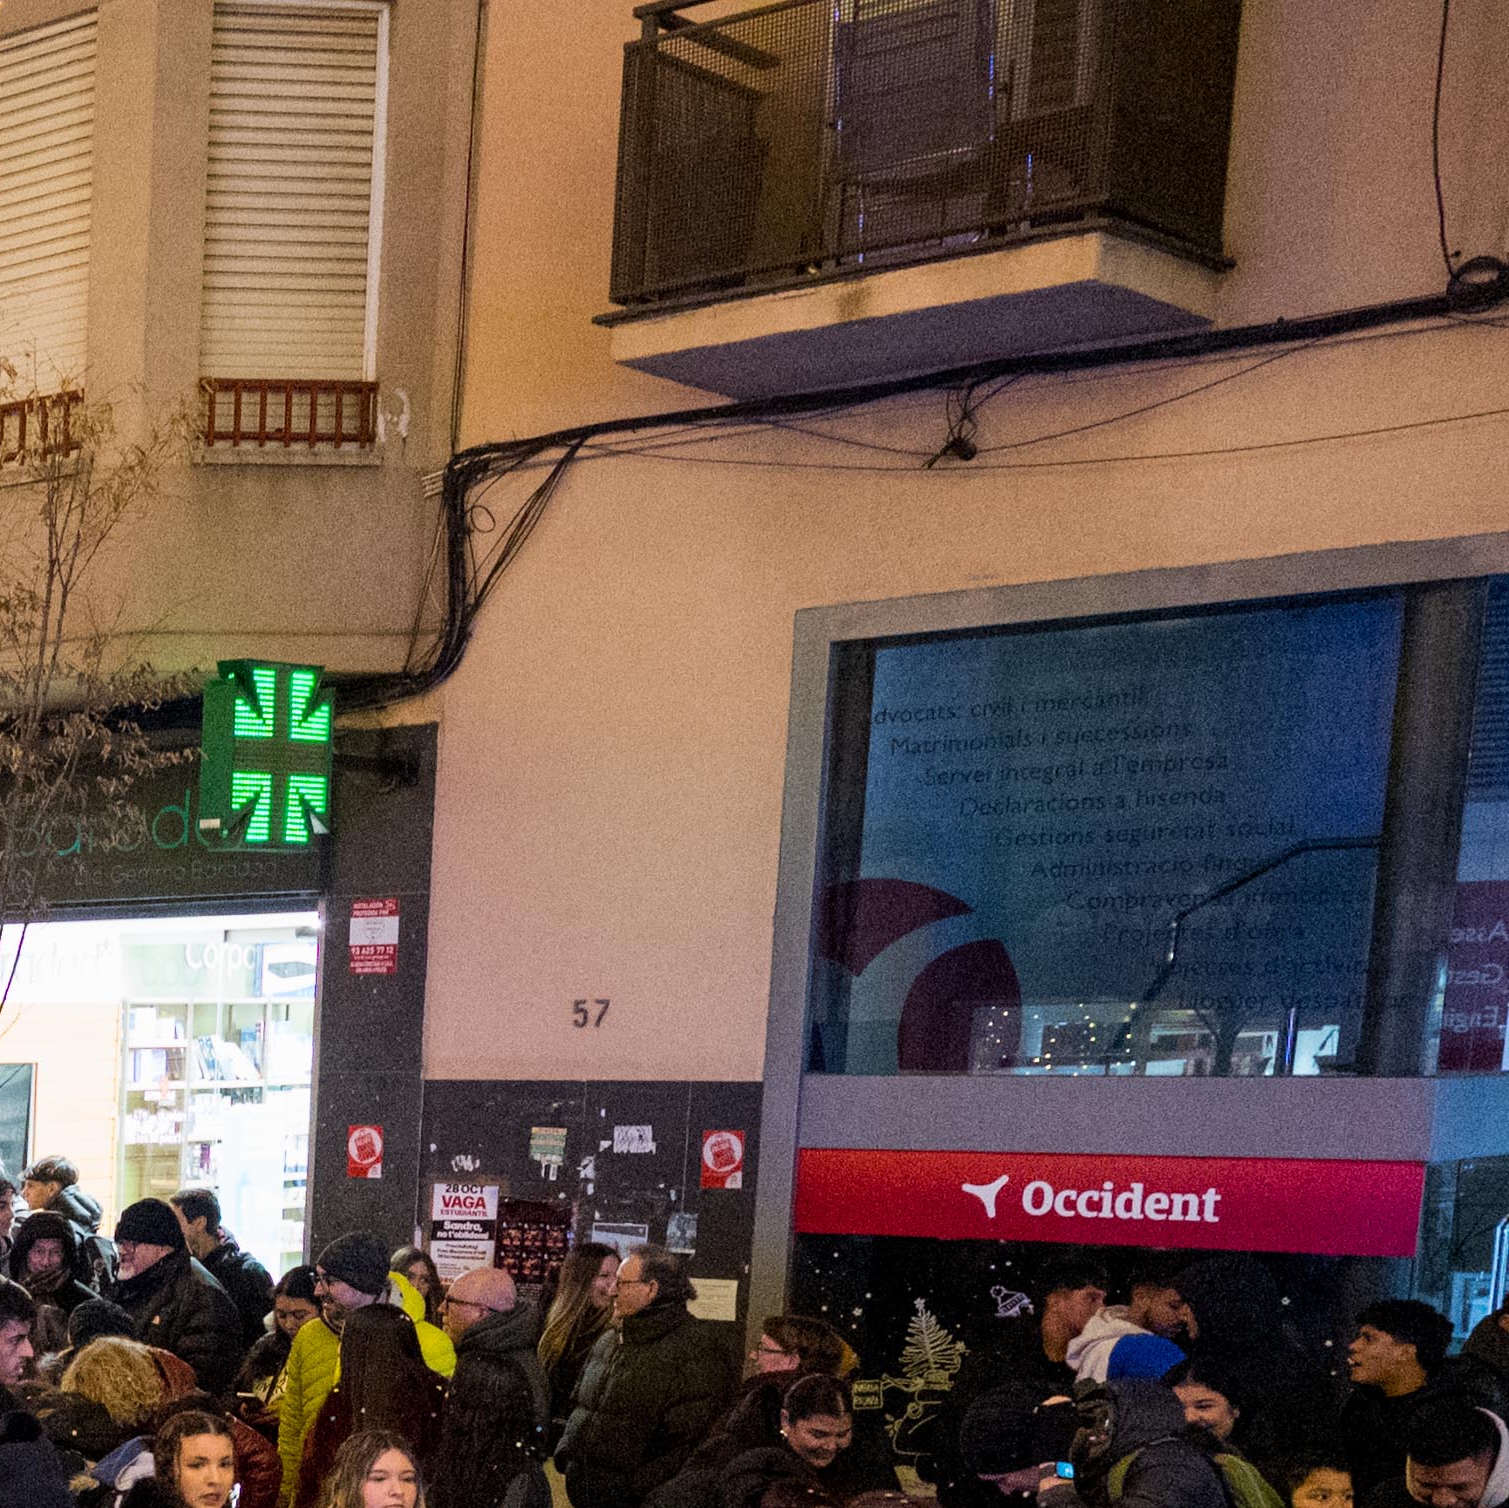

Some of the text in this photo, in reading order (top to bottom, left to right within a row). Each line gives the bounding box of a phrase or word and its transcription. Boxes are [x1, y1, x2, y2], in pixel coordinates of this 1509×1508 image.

[572, 999, 611, 1029] 57
[441, 1195, 486, 1209] VAGA
[1021, 1181, 1221, 1223] Occident
